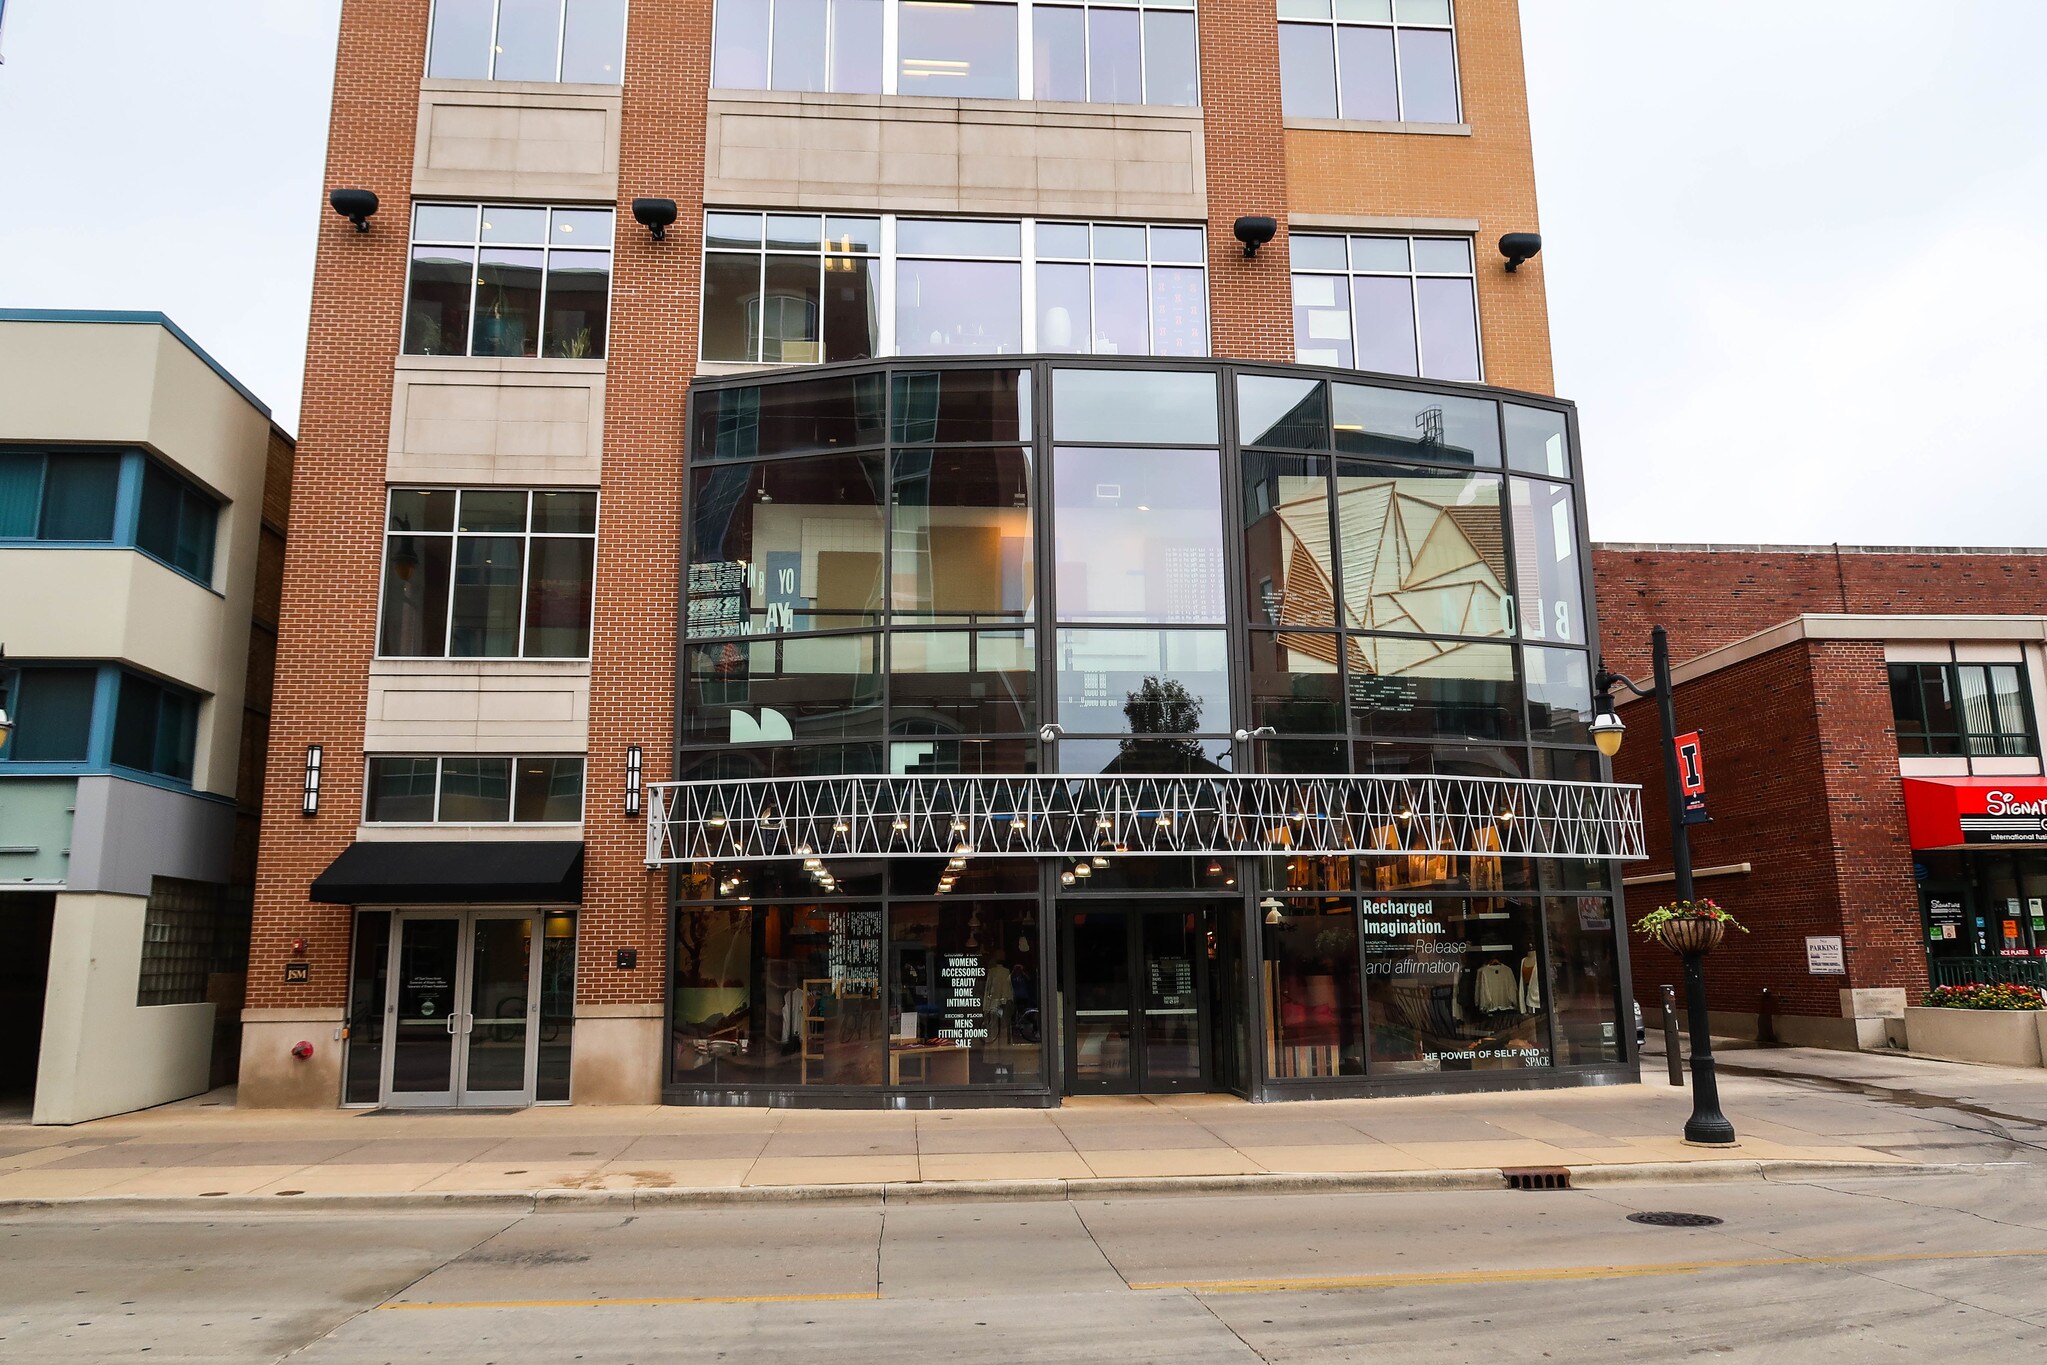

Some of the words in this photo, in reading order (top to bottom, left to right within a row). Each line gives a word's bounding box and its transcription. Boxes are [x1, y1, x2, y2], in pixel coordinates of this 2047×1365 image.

[1681, 743, 1700, 788] I
[1363, 899, 1433, 918] Recharged
[1364, 919, 1447, 937] Imagination.
[1415, 939, 1468, 954] Release
[948, 957, 979, 967] WOMENS
[1365, 959, 1392, 975] and
[1394, 958, 1463, 974] affirmation.
[287, 969, 307, 980] JSM
[941, 967, 986, 977] ACCESSORIES
[951, 977, 976, 987] BEAUTY
[954, 988, 974, 997] HOME
[946, 998, 982, 1007] INTIMATES
[954, 1019, 974, 1028] MENS
[938, 1029, 963, 1039] FITTING
[964, 1028, 988, 1038] ROOMS
[955, 1038, 972, 1048] SALE
[1422, 1052, 1438, 1060] HE
[1440, 1050, 1476, 1060] POWER
[1478, 1049, 1492, 1058] OF
[1494, 1048, 1517, 1058] SELF
[1519, 1048, 1540, 1057] AND
[1525, 1056, 1550, 1067] SPACE
